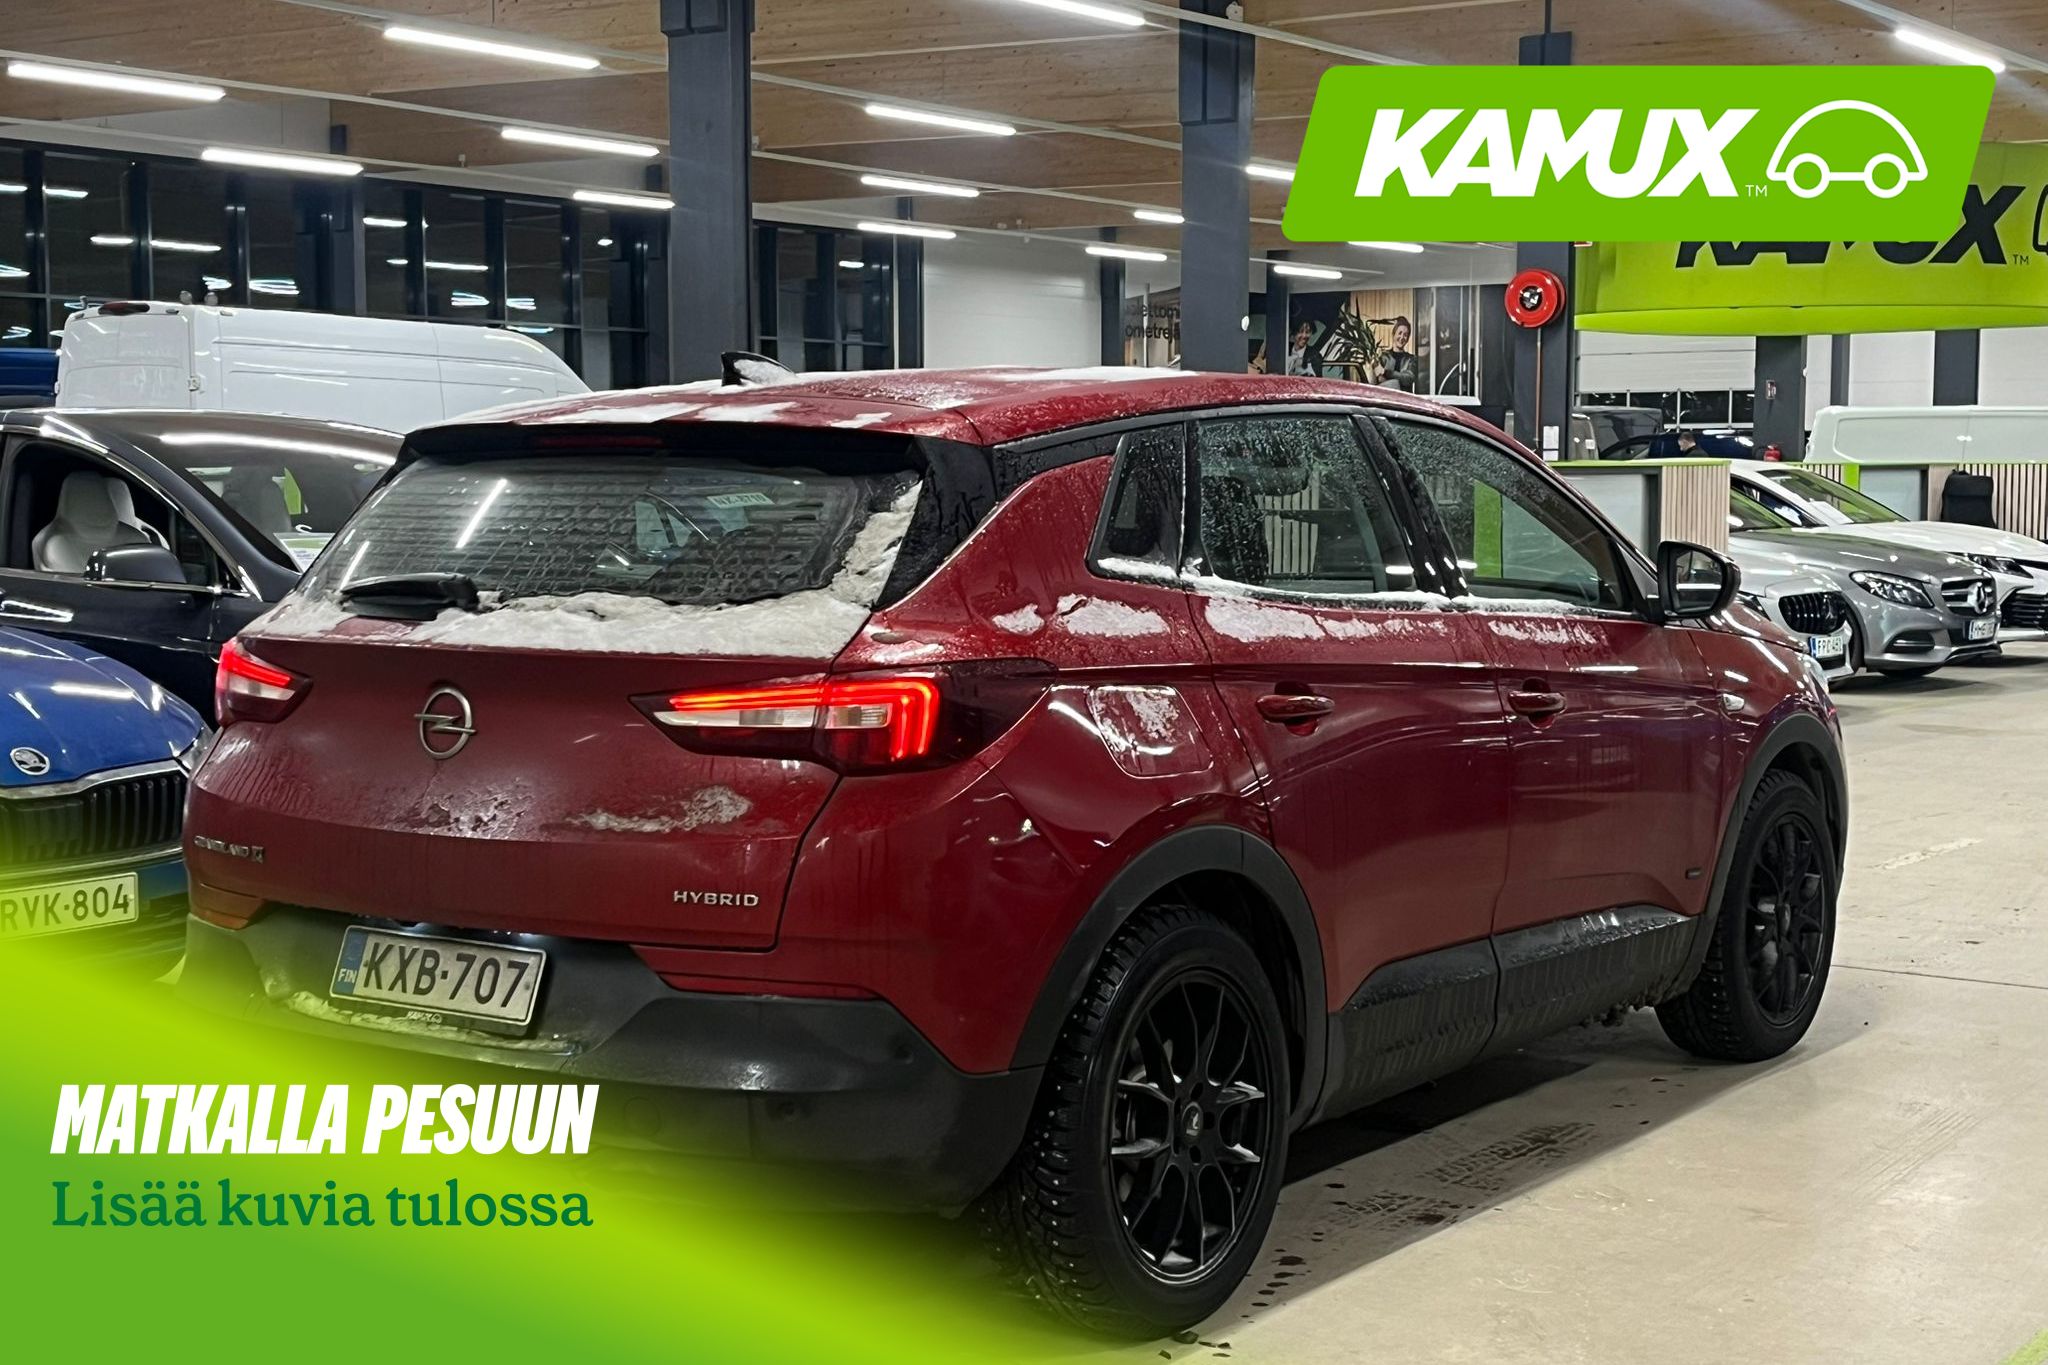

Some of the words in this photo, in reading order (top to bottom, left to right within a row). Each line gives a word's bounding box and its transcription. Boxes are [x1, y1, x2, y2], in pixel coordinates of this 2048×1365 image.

[0, 884, 130, 932] RVK-804
[673, 891, 759, 906] HYBRID
[338, 968, 358, 984] FIN
[363, 942, 530, 1008] KXB-707
